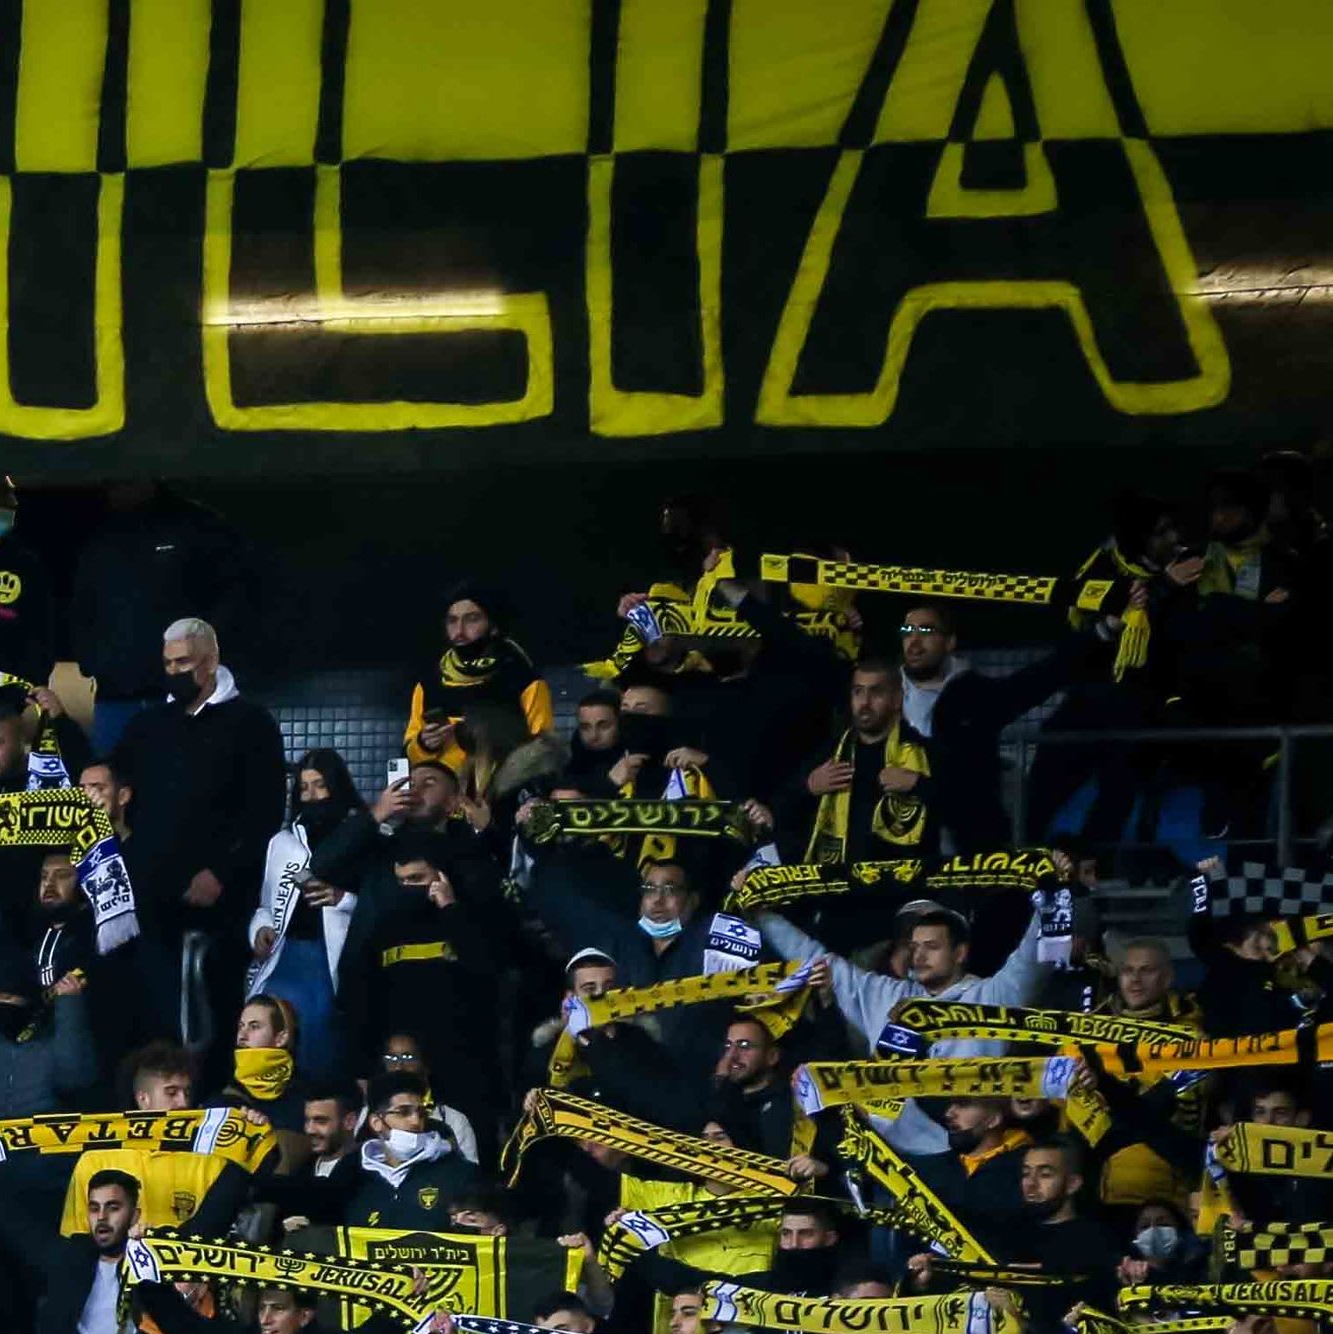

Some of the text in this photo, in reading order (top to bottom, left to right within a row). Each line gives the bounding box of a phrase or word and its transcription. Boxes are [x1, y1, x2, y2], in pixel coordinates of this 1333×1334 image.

[570, 803, 720, 827] ירושלים
[3, 1115, 195, 1148] BETAR
[157, 1243, 265, 1276] ירושלים
[374, 1244, 470, 1262] בית"ר ירושלים
[310, 1264, 426, 1318] JERUSALEM
[775, 1299, 924, 1331] ירושלים
